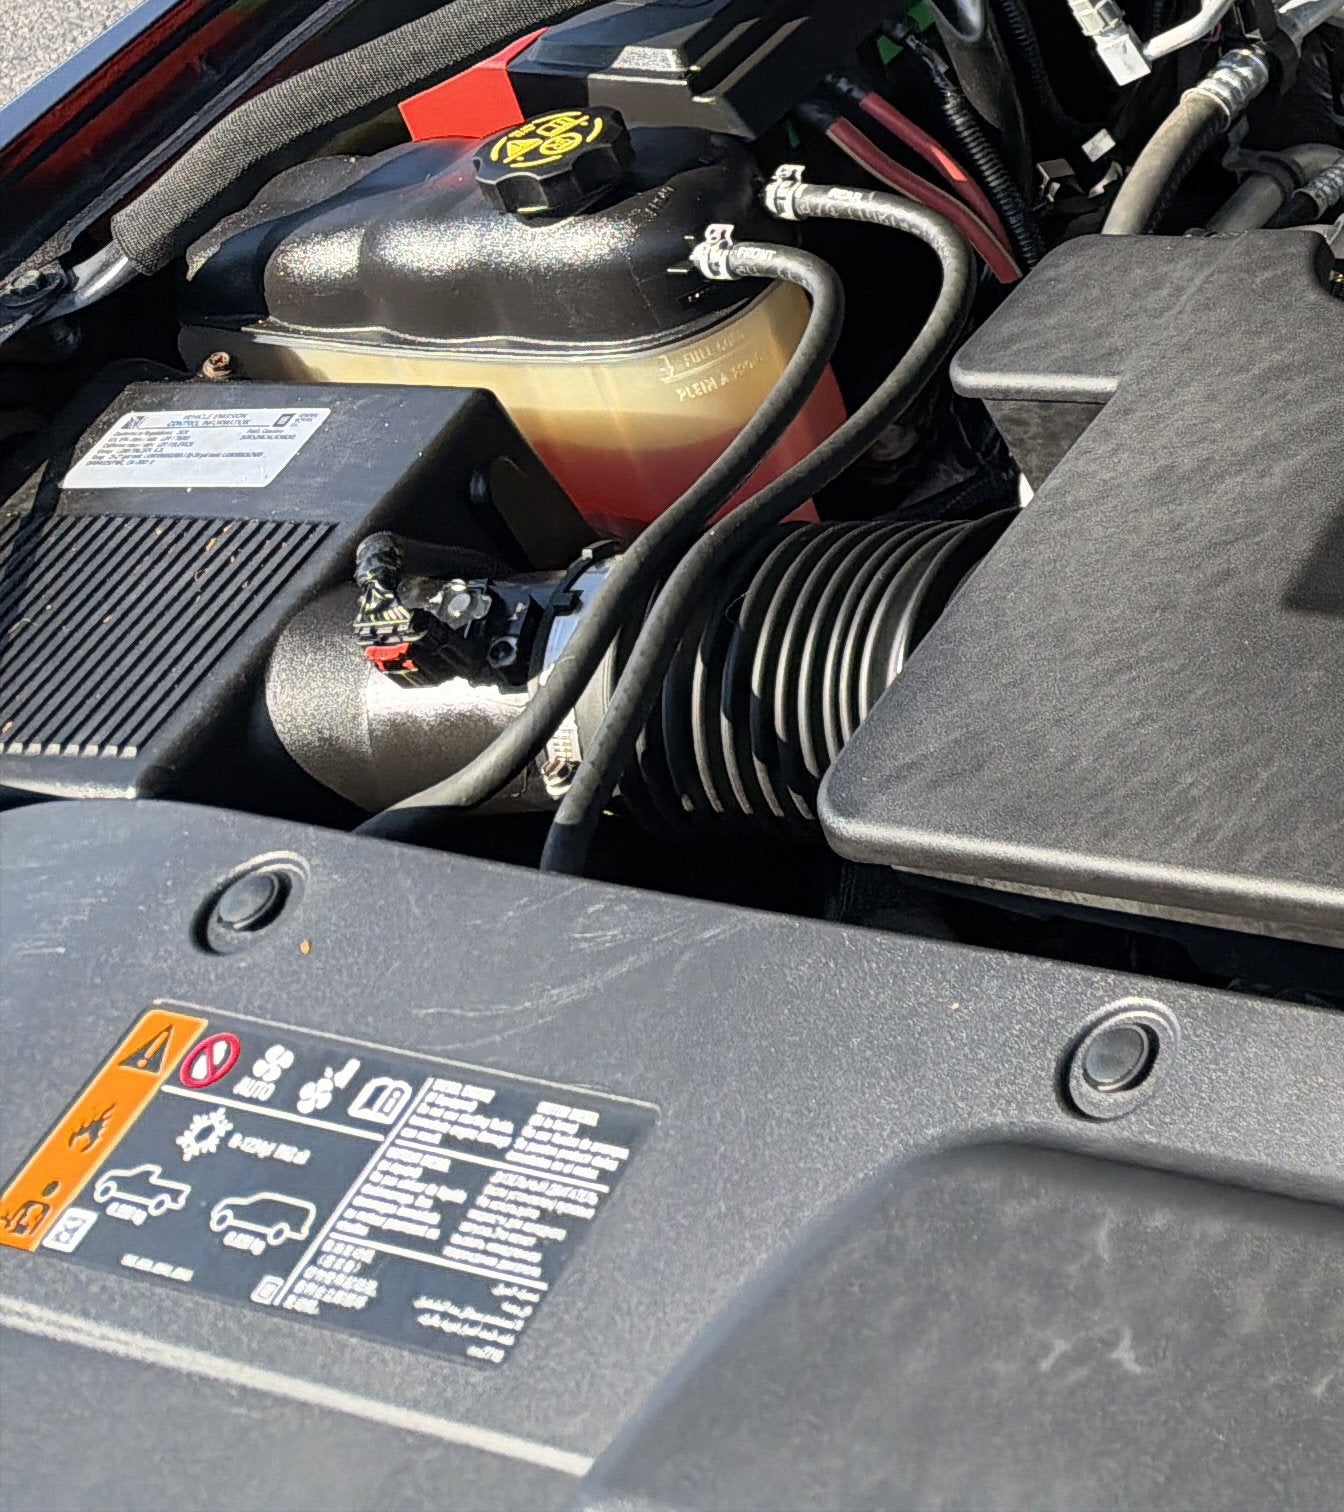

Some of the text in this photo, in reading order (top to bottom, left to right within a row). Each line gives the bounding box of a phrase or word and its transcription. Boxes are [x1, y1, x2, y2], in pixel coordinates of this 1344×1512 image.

[828, 188, 863, 203] REAR
[737, 247, 776, 261] FRONT
[233, 1076, 276, 1102] AUTO
